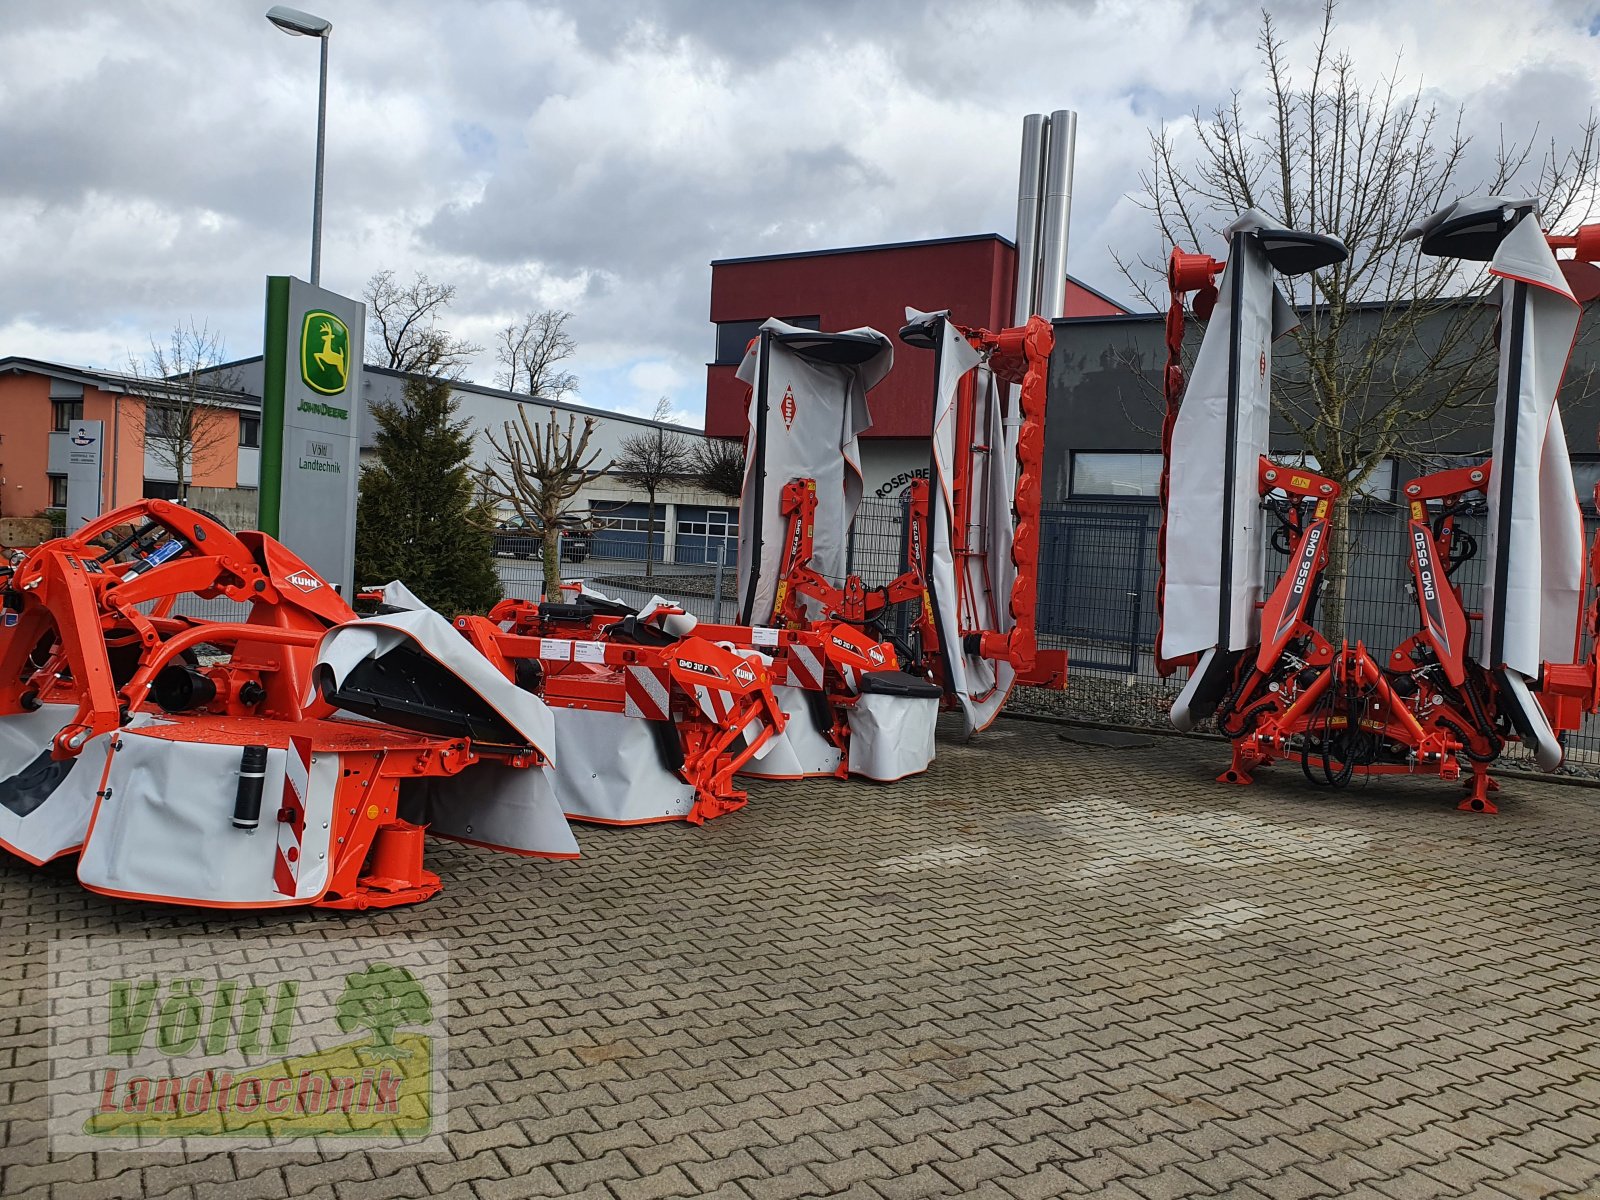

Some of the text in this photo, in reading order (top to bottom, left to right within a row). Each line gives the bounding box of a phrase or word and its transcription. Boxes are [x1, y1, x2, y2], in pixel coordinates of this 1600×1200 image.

[297, 398, 349, 420] JOHN DEERE
[785, 390, 793, 426] KUHN
[298, 457, 341, 474] Landtechnik
[1293, 529, 1321, 594] GMD 9530
[1414, 532, 1435, 601] GMD 9530
[291, 575, 318, 589] KUHN
[832, 636, 843, 645] GMD
[869, 649, 884, 663] KUHN
[679, 659, 693, 669] GMD
[693, 663, 703, 672] 310
[736, 668, 753, 681] KUHN
